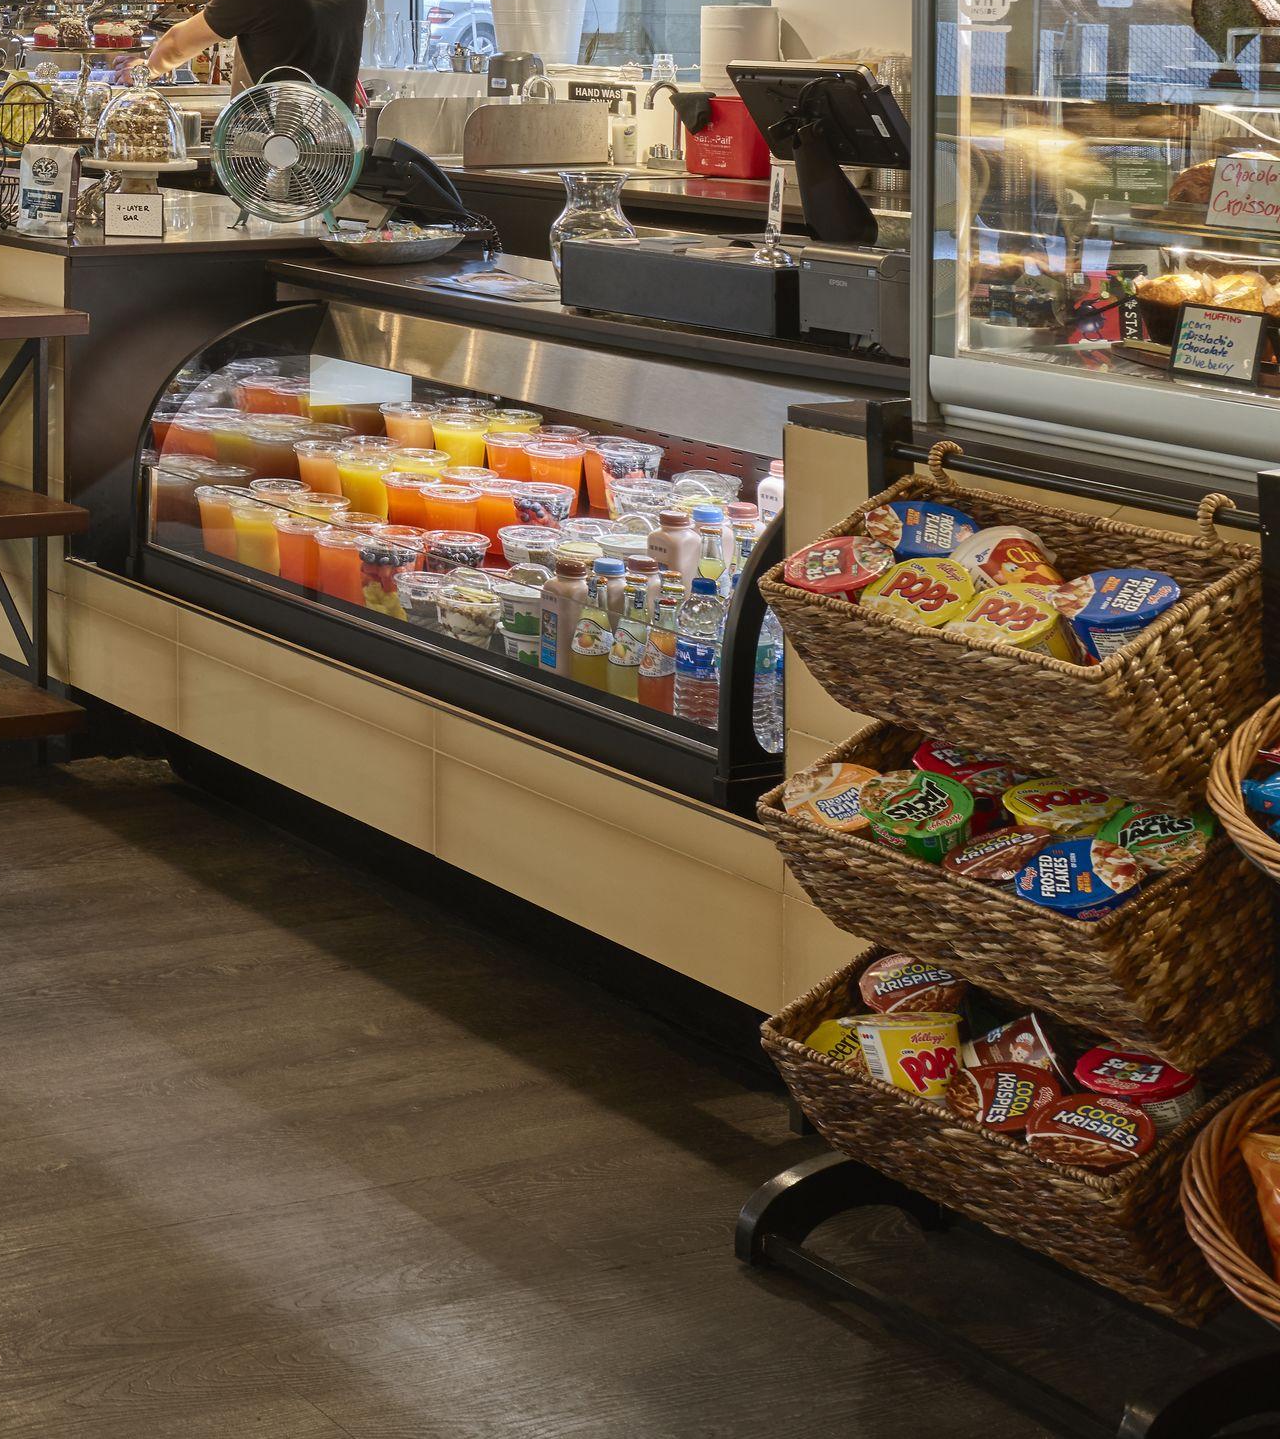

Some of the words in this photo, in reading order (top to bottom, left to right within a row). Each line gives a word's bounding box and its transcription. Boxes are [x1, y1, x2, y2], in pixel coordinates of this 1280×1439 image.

[575, 87, 600, 97] HAND
[1221, 162, 1280, 187] Chocola
[116, 205, 150, 213] 7-LAYER
[123, 214, 139, 222] BAR
[829, 278, 848, 288] EPSON
[1204, 311, 1243, 325] MUFFINS
[923, 512, 940, 545] FLAKES
[938, 512, 955, 550] FROSTED
[910, 562, 926, 573] CORN
[879, 570, 961, 612] POPS
[996, 589, 1013, 599] CORN
[1110, 577, 1140, 611] FLAKES
[1125, 576, 1158, 613] FROSTED
[966, 596, 1050, 632] POPS
[883, 777, 950, 822] JACKS
[912, 799, 949, 822] APPLE
[1025, 788, 1111, 813] POPS
[954, 832, 1036, 864] KRISPIES
[962, 832, 1022, 855] COCOA
[1117, 817, 1194, 849] JACKS
[1038, 854, 1057, 899] FROSTED
[1053, 856, 1072, 894] FLAKES
[873, 969, 954, 997] KRISPIES
[879, 964, 938, 983] COCOA
[909, 1031, 948, 1045] Kellogg's
[898, 1046, 957, 1094] POPS
[985, 1071, 1017, 1125] KRISPIES
[1007, 1080, 1035, 1119] COCOA
[1051, 1110, 1140, 1149] KRISPIES
[1075, 1104, 1138, 1136] COCOA
